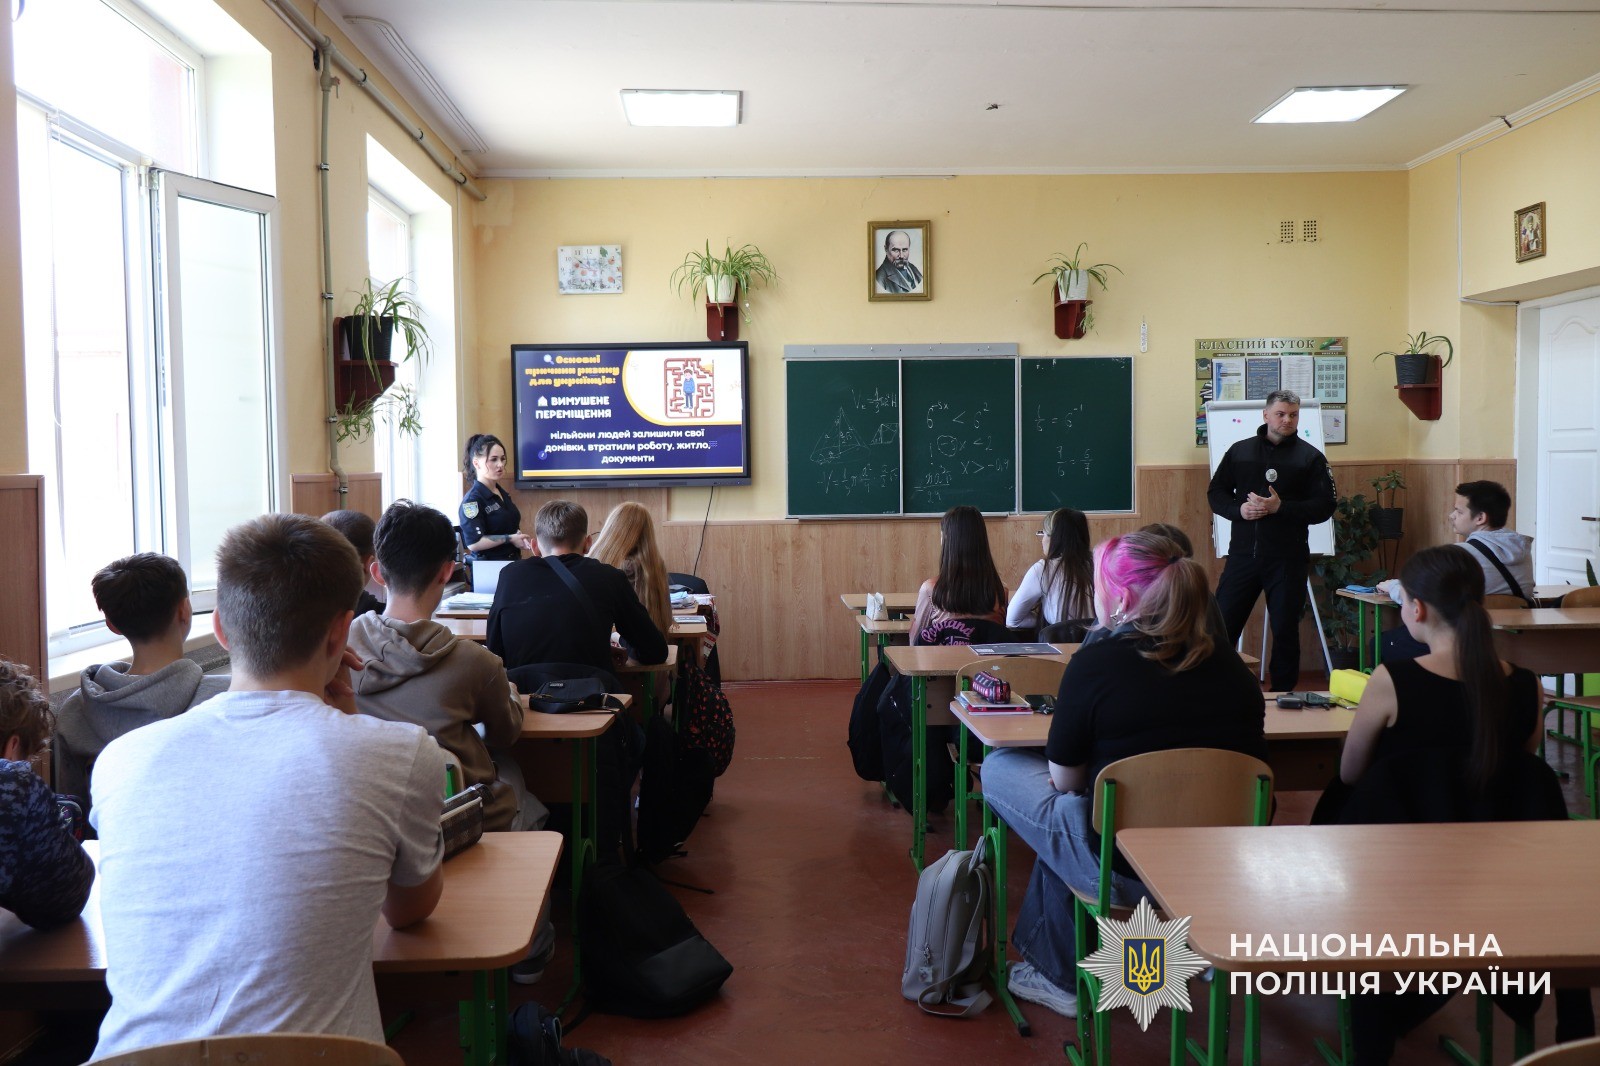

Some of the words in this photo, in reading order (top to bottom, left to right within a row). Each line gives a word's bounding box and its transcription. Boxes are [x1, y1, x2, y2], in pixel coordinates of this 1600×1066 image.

[1199, 339, 1266, 350] КЛАСНИЙ
[1271, 340, 1315, 349] КУТОК
[556, 354, 600, 364] Основні
[550, 396, 610, 406] ВИМУШЕНЕ
[536, 409, 612, 420] ПЕРЕМІЩЕННЯ
[550, 431, 596, 440] мільйони
[598, 429, 630, 440] людей
[632, 430, 682, 438] залишили
[684, 428, 705, 438] свої
[588, 442, 636, 452] втратили
[601, 454, 655, 464] документи
